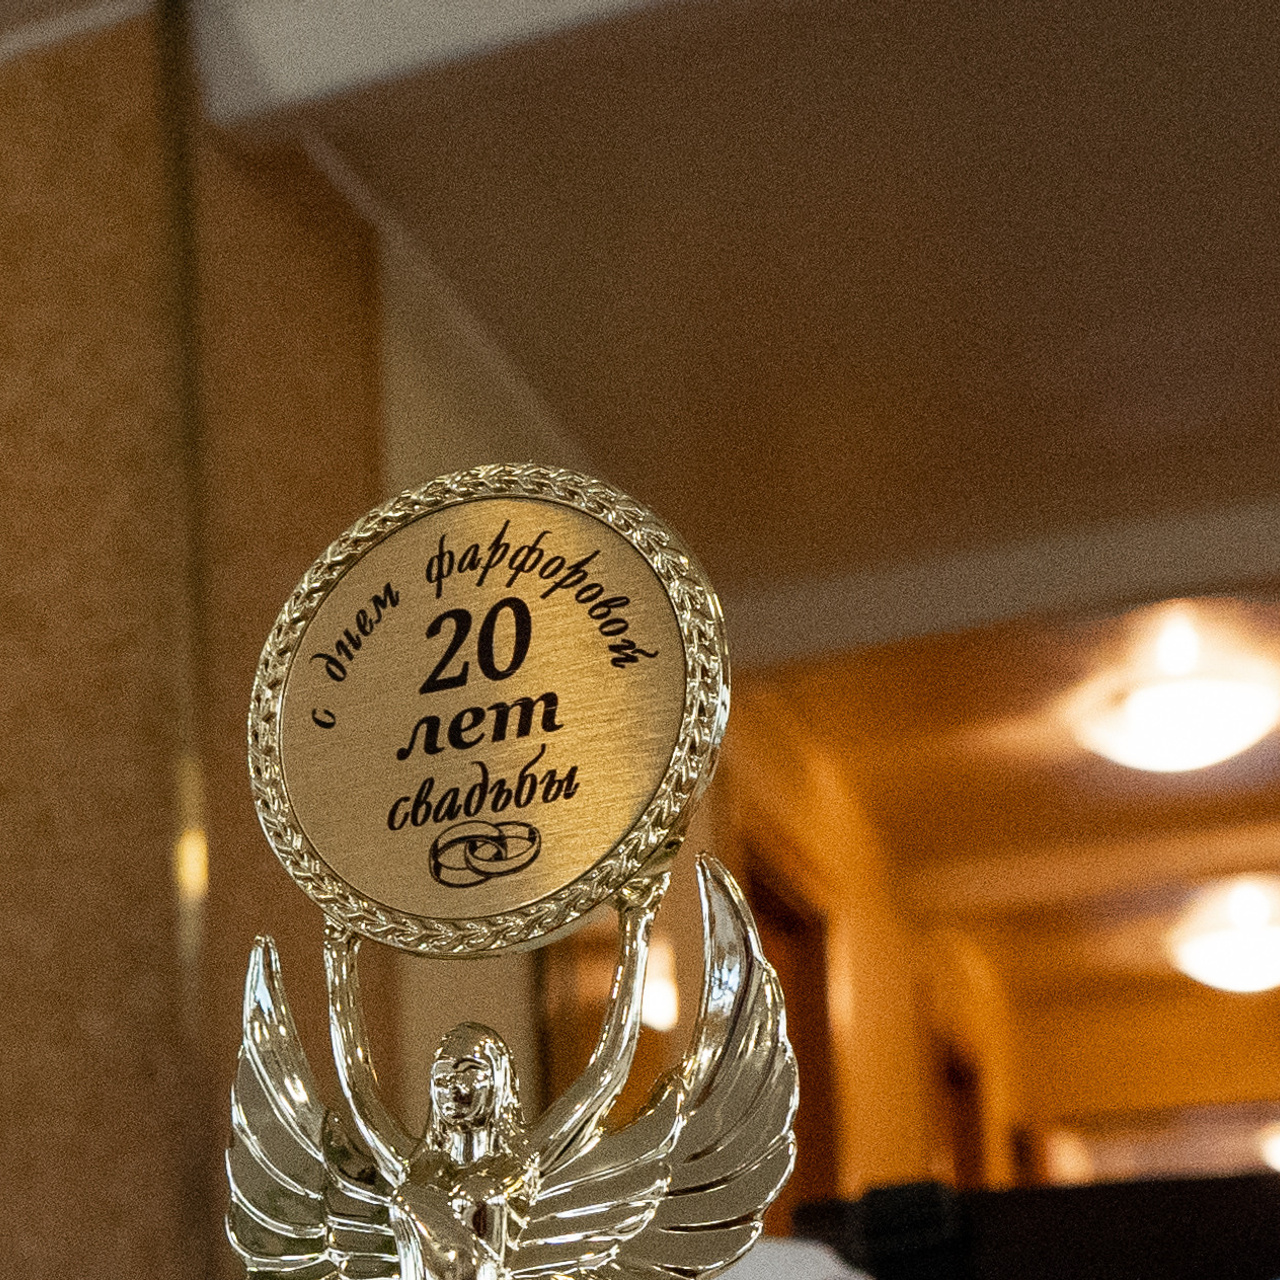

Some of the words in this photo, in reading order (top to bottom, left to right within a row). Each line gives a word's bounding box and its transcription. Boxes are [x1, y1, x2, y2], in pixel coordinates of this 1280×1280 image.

[310, 581, 400, 683] днем
[424, 519, 659, 669] фарфоровой
[419, 596, 532, 695] 20
[396, 690, 564, 762] лет
[387, 744, 580, 832] свадьбы
